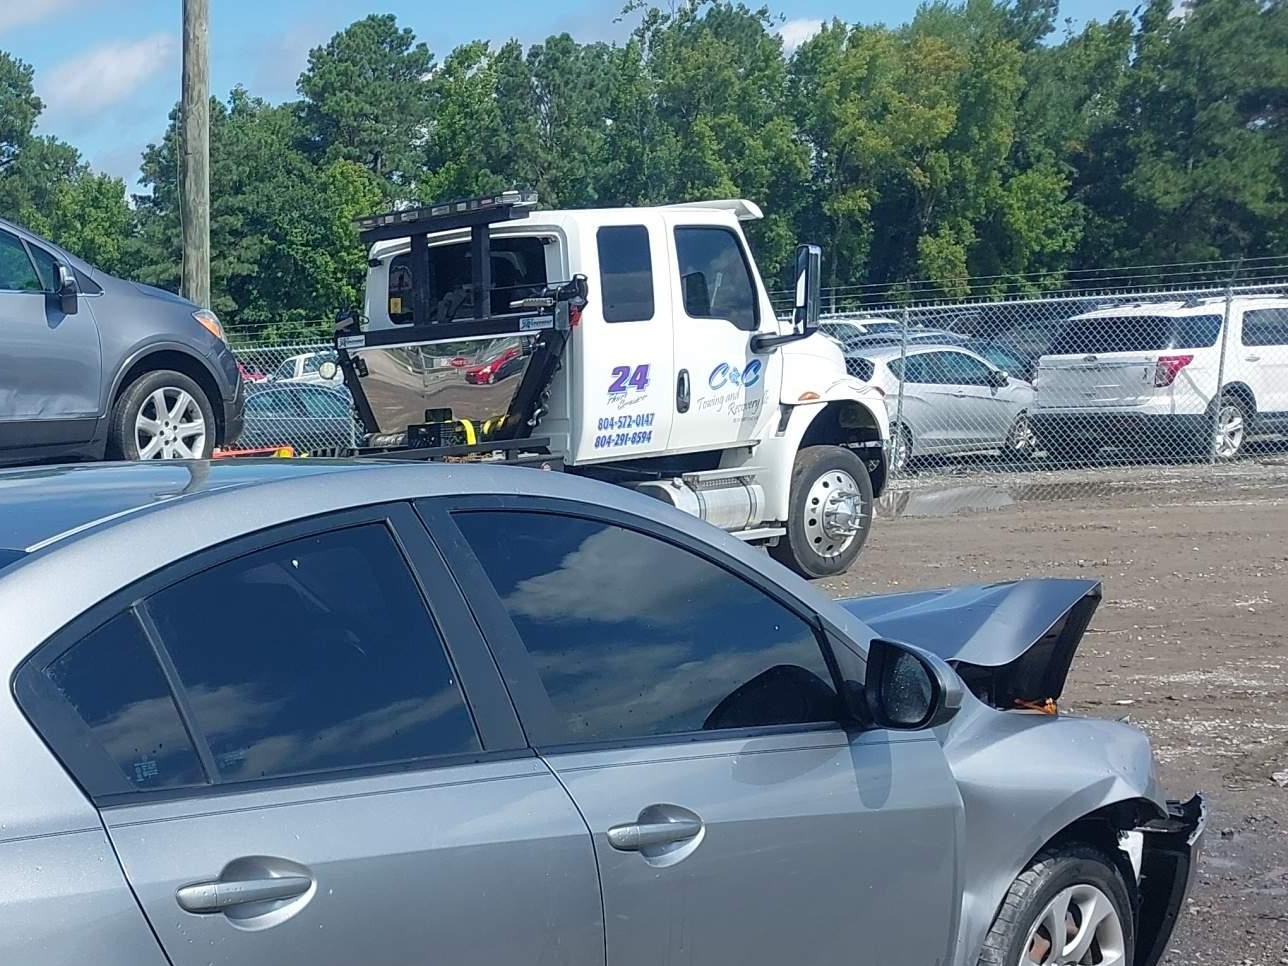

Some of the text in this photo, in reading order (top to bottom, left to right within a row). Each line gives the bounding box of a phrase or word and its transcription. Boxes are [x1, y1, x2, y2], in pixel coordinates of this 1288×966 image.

[608, 364, 650, 393] 24
[598, 413, 655, 431] 804-572-0147
[594, 431, 653, 449] 804-291-8594
